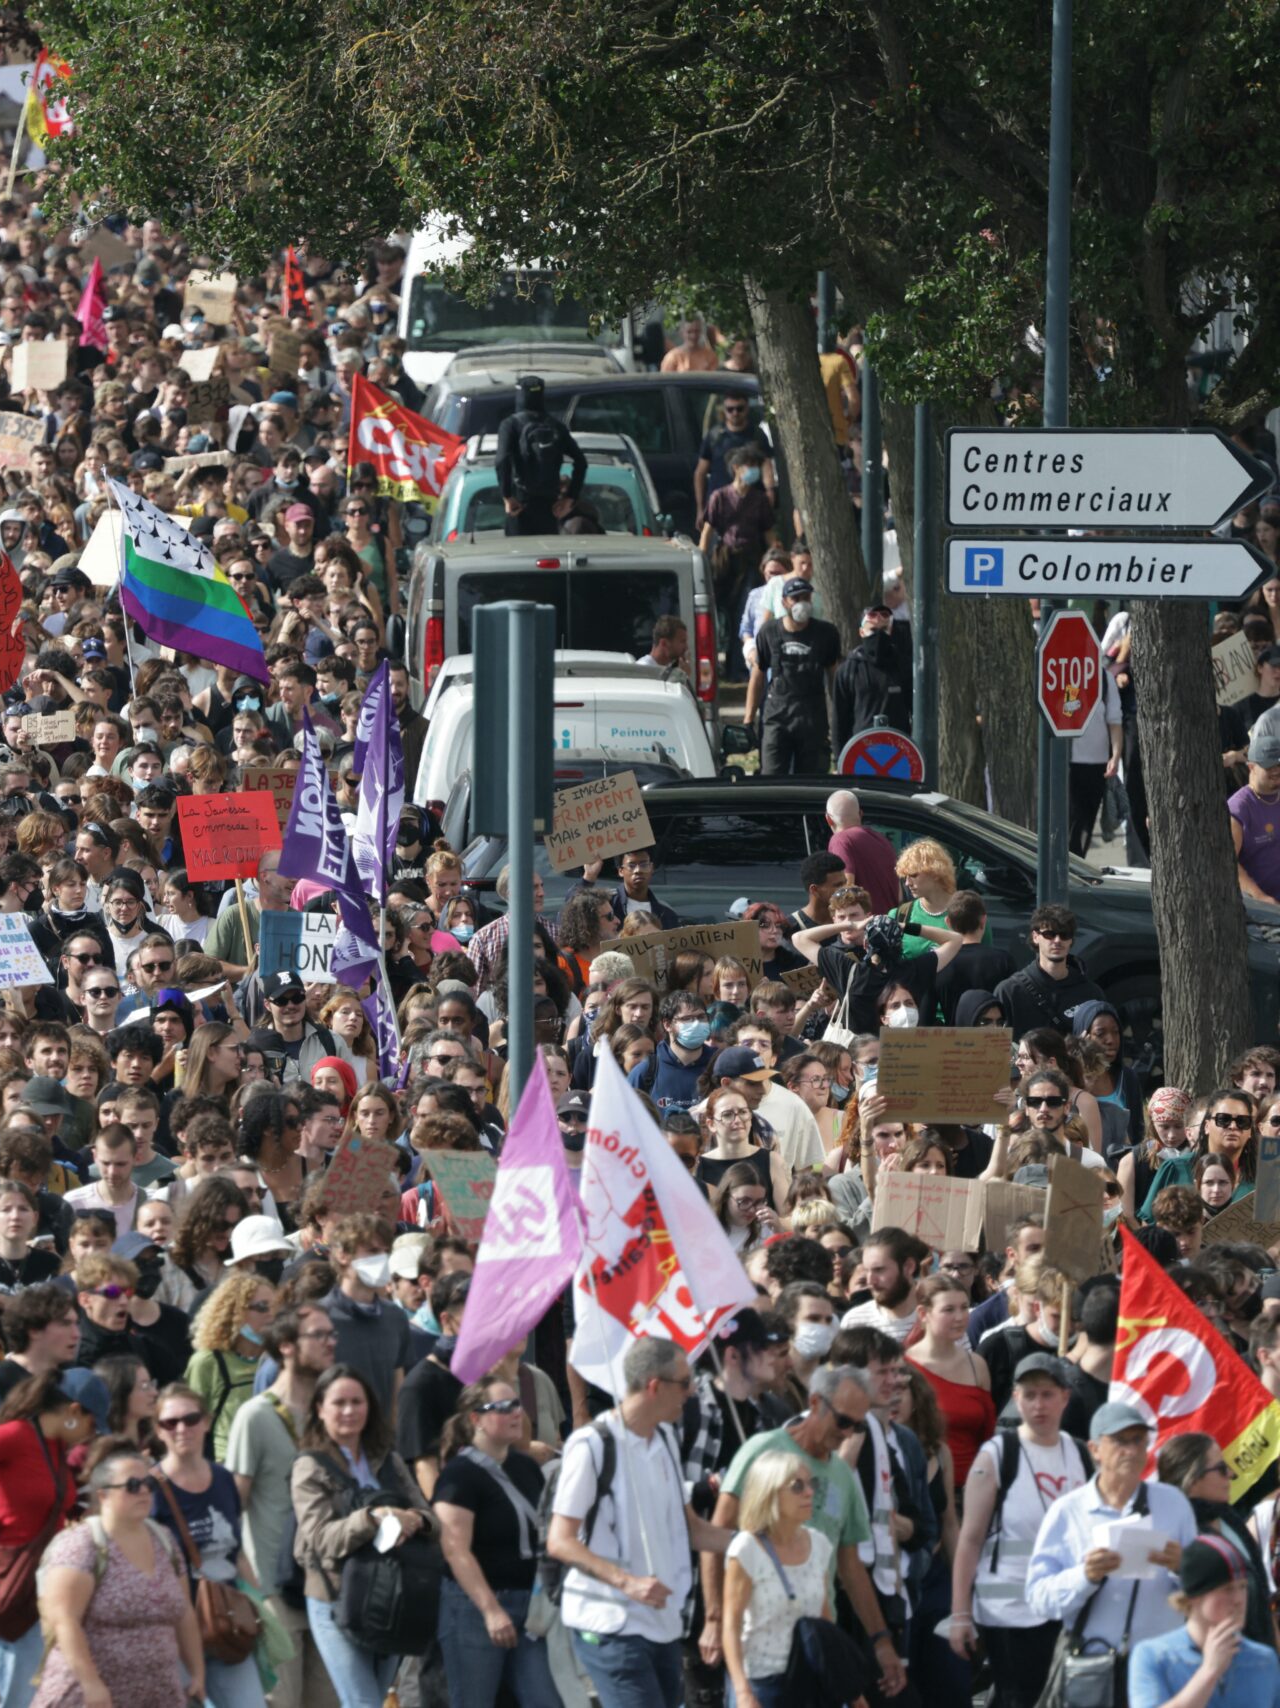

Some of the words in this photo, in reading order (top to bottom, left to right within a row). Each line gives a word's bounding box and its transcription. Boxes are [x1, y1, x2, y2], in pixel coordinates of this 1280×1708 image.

[357, 416, 446, 495] cgt
[963, 446, 1084, 474] Centres
[962, 484, 1172, 513] Commerciaux
[973, 554, 995, 581] P
[1018, 554, 1193, 583] Colombier
[1046, 657, 1095, 691] STOP
[610, 726, 666, 738] Peinture
[244, 773, 269, 791] LA
[572, 777, 617, 802] IMAGES
[553, 786, 635, 830] FRAPPENT
[622, 808, 642, 822] QUE
[556, 846, 575, 864] LA
[305, 913, 332, 933] LA
[668, 929, 736, 951] SOUTIEN
